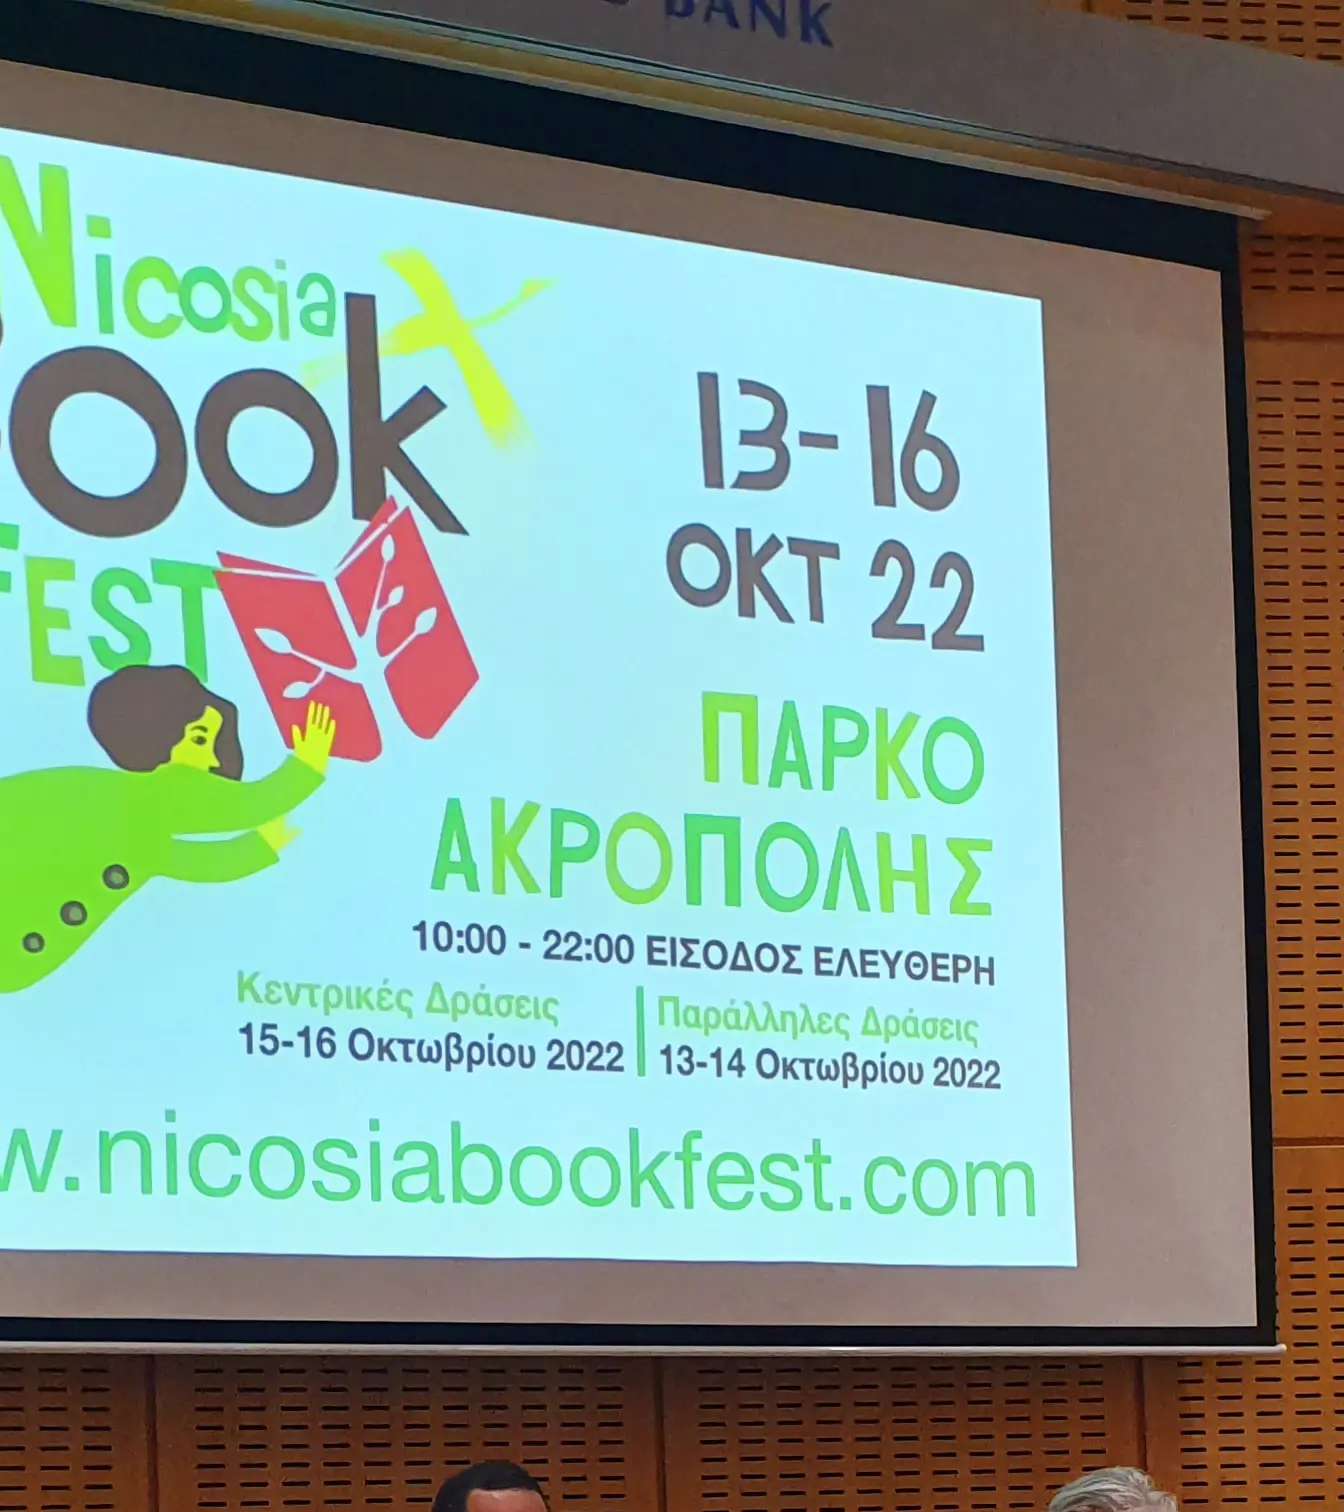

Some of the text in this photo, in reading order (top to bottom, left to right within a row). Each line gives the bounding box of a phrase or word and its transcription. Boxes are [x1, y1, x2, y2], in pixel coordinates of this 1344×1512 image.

[666, 522, 985, 652] ΟΚΤ 22
[701, 690, 985, 805] ΠΑΡΚΟ
[430, 796, 994, 917] ΑΚΡΟΠΟΛΗΣ
[412, 919, 507, 956] 10:00
[542, 929, 635, 964] 22:00
[646, 934, 804, 976] ΕΙΣΟΔΟΣ
[813, 946, 996, 986] ΕΛΕΥΘΕΡΗ
[236, 969, 561, 1028] Κεντρικές Δράσεις
[657, 995, 980, 1049] Παράλληλες Δράσεις
[238, 1021, 626, 1074] 15-16 Οκτωβρίου 2022
[659, 1043, 1002, 1091] 13-14 Οκτωβρίου 2022
